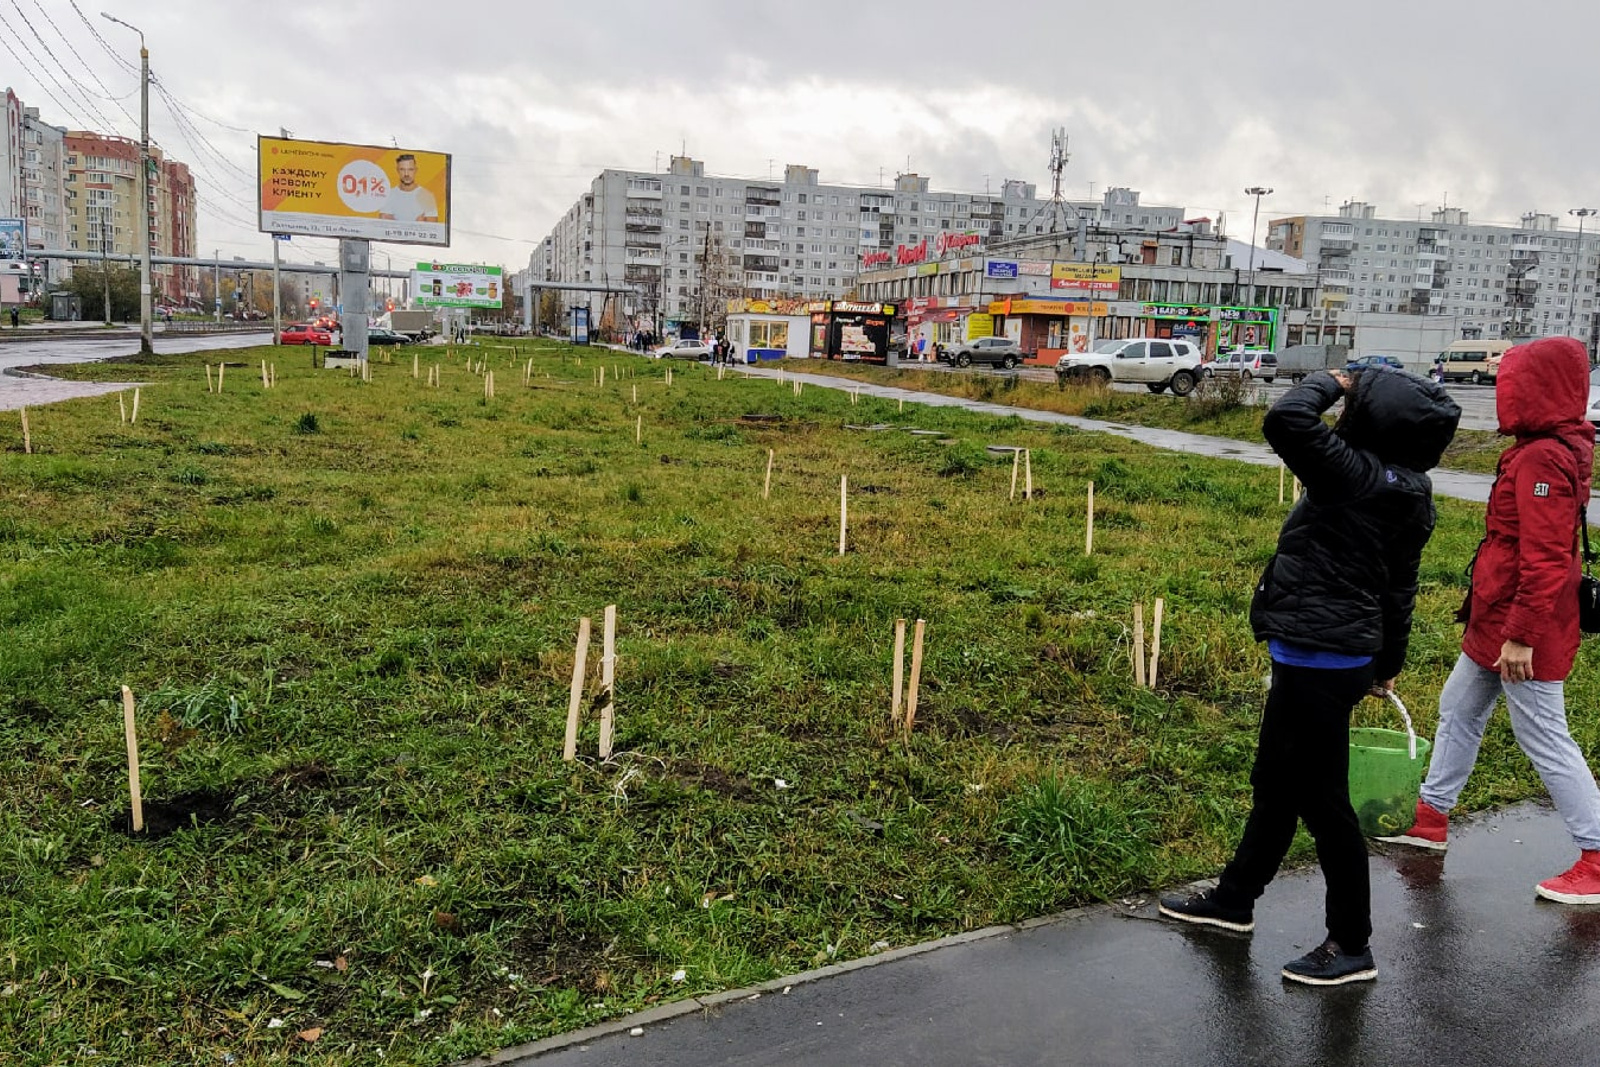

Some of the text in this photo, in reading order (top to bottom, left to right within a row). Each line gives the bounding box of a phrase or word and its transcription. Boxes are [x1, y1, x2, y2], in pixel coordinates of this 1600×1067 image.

[273, 168, 327, 178] КАЖДОМУ
[273, 179, 317, 188] НОВОМУ
[273, 188, 321, 198] КЛИЕНТУ
